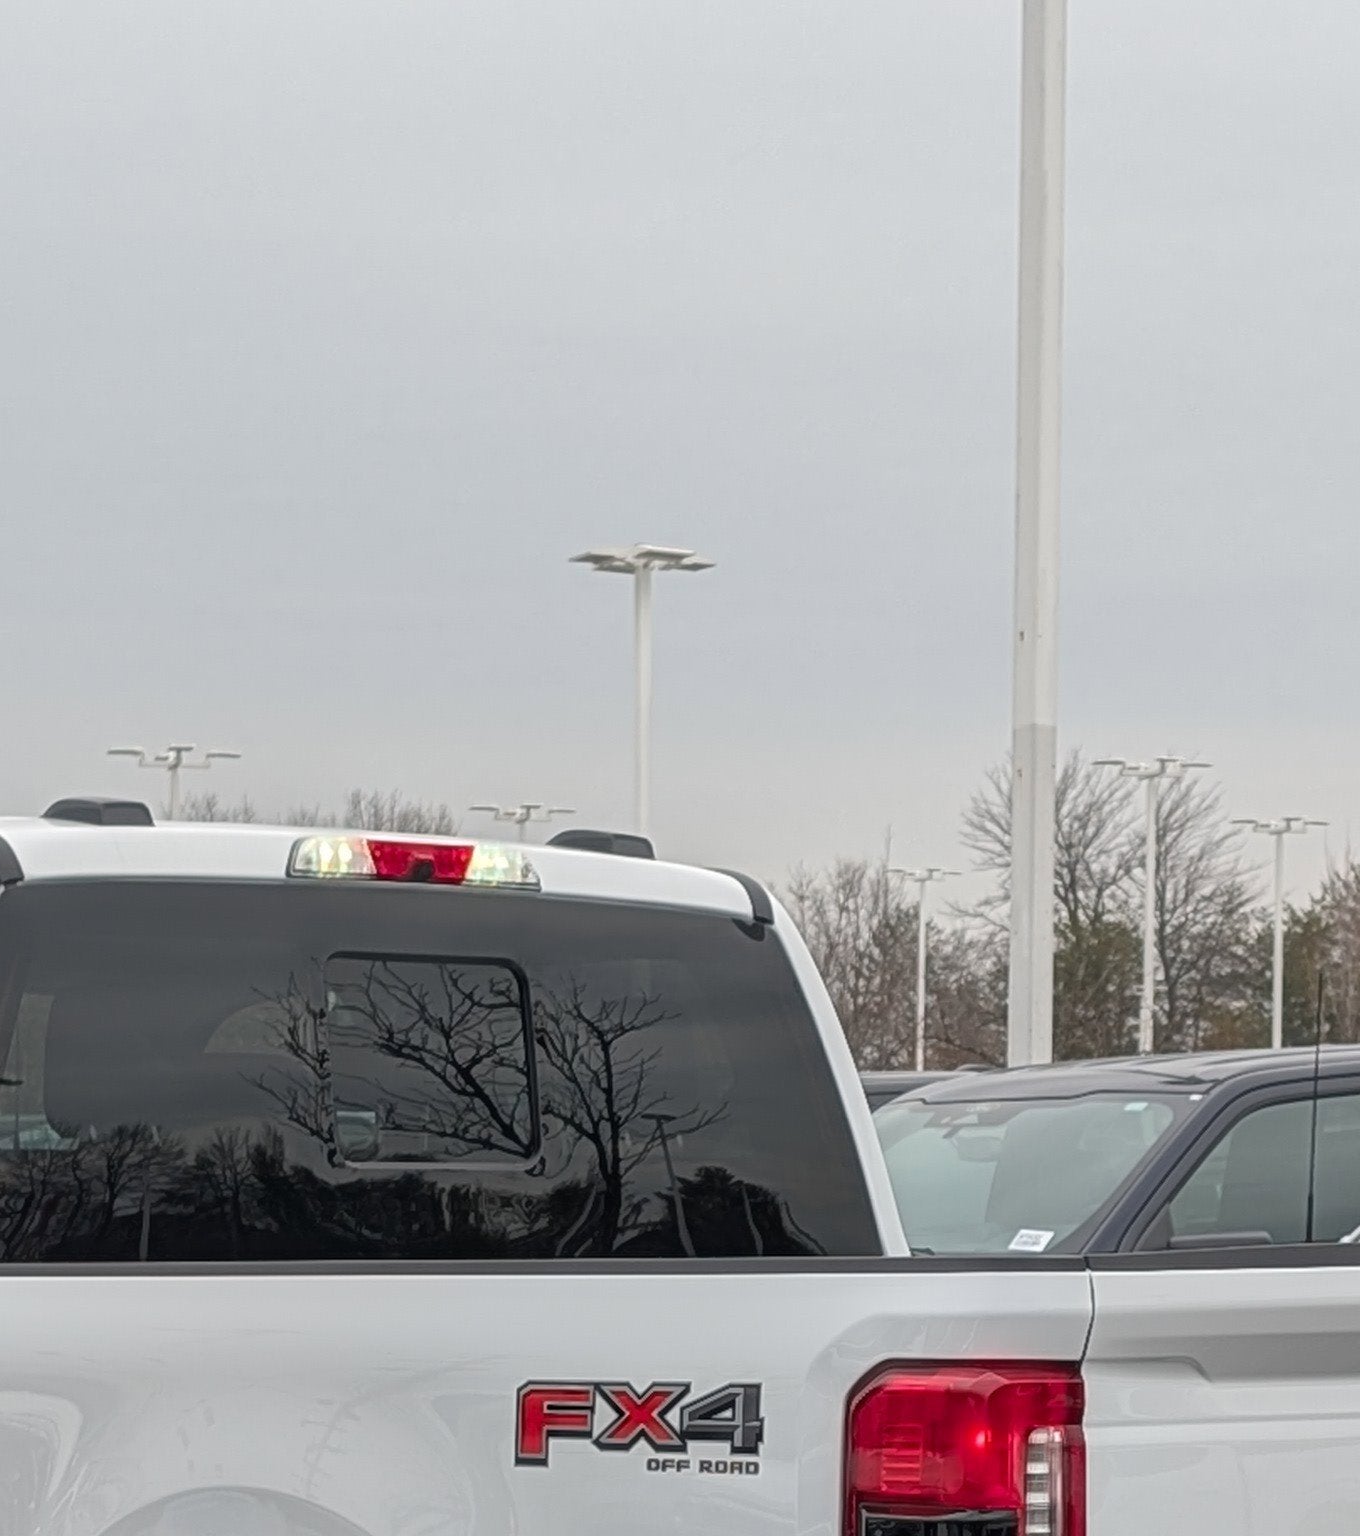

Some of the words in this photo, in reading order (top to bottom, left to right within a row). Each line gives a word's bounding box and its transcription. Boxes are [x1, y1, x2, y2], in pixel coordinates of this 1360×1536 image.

[515, 1380, 764, 1467] FX4
[646, 1458, 690, 1472] OFF
[698, 1459, 760, 1475] ROAD
